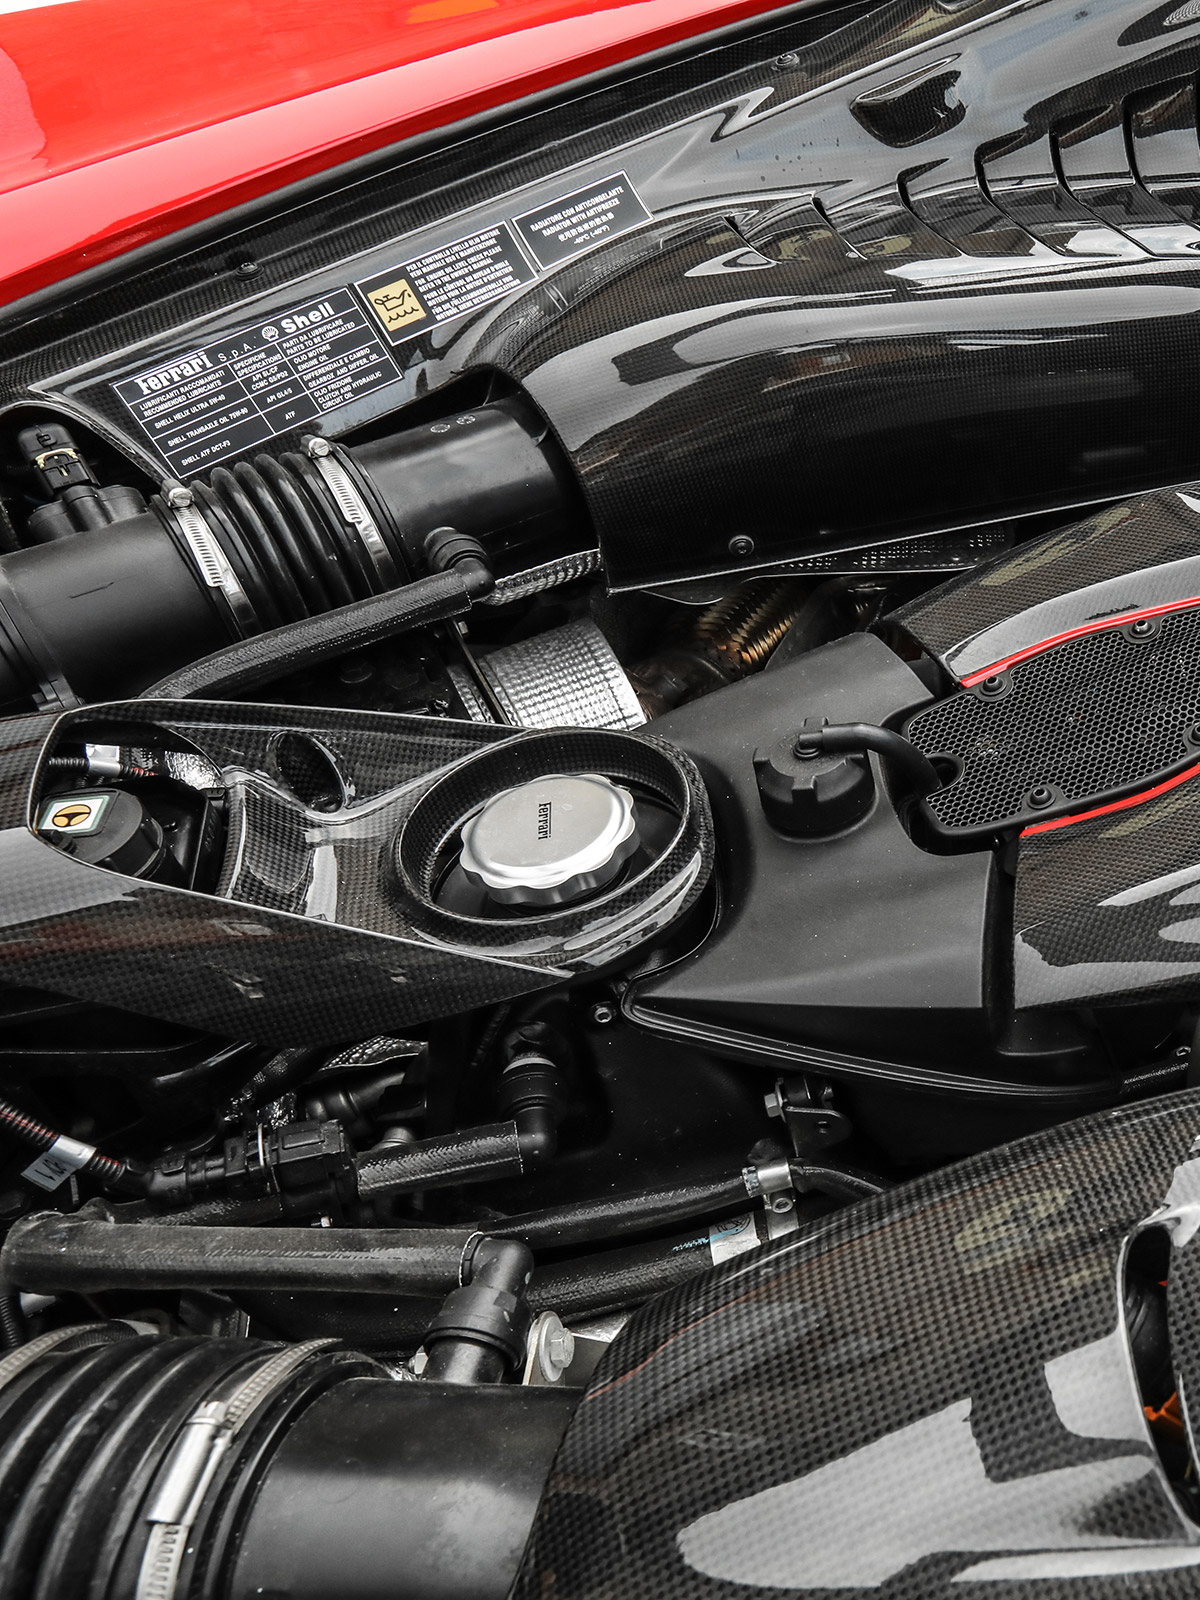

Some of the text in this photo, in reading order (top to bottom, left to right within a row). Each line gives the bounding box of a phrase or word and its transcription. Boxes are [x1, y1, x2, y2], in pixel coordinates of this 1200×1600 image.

[530, 186, 624, 232] RADIATORE CON ANTICONGELANTE
[541, 197, 620, 237] RADIATOR WITH ANTIFREEZE
[406, 263, 418, 272] PER
[421, 249, 451, 265] CONTROLLO
[449, 241, 469, 254] LIVELLO
[468, 237, 481, 246] OLIO
[479, 228, 500, 241] MOTORE
[414, 245, 502, 286] FOR ENGINE OIL LEVEL CHECK PLEASE
[418, 282, 435, 293] REFER
[440, 275, 451, 283] THE
[471, 257, 494, 270] MANUAL
[280, 302, 335, 333] Shell
[282, 318, 344, 349] PARTI DA LUBRIFICARE
[286, 343, 305, 355] PARTS
[313, 336, 322, 344] BE
[321, 321, 355, 340] LUBRICATED
[132, 343, 258, 395] Ferrari S.p.A.
[233, 352, 267, 370] SPECIFICHE
[237, 353, 282, 377] SPECIFICATIONS
[293, 343, 331, 364] OLIO MOTORE
[297, 354, 329, 371] ENGINE OIL
[302, 359, 344, 381] DIFFERENZIALE
[349, 347, 370, 361] CAMBIO
[251, 379, 268, 390] CCMC
[252, 373, 262, 382] API
[308, 372, 335, 388] GEARBOX
[336, 366, 348, 376] AND
[369, 353, 379, 361] OIL
[139, 370, 225, 411] LUBRIFICANTI RACCOMANDATI
[143, 379, 222, 417] RECOMMENDED LUBRICANTS
[266, 394, 277, 403] API
[313, 376, 353, 397] OLIO FRIZIONE
[318, 371, 382, 404] CLUTCH AND HYDRAULIC
[322, 395, 344, 409] CIRCUIT
[154, 417, 174, 429] SHELL
[173, 409, 191, 421] HELIX
[190, 401, 209, 413] ULTRA
[285, 411, 295, 420] ATF
[167, 435, 187, 447] SHELL
[186, 420, 219, 438] TRANSAXLE
[219, 416, 229, 424] OIL
[181, 454, 200, 466] SHELL
[200, 448, 210, 458] ATF
[538, 801, 552, 840] Ferrari
